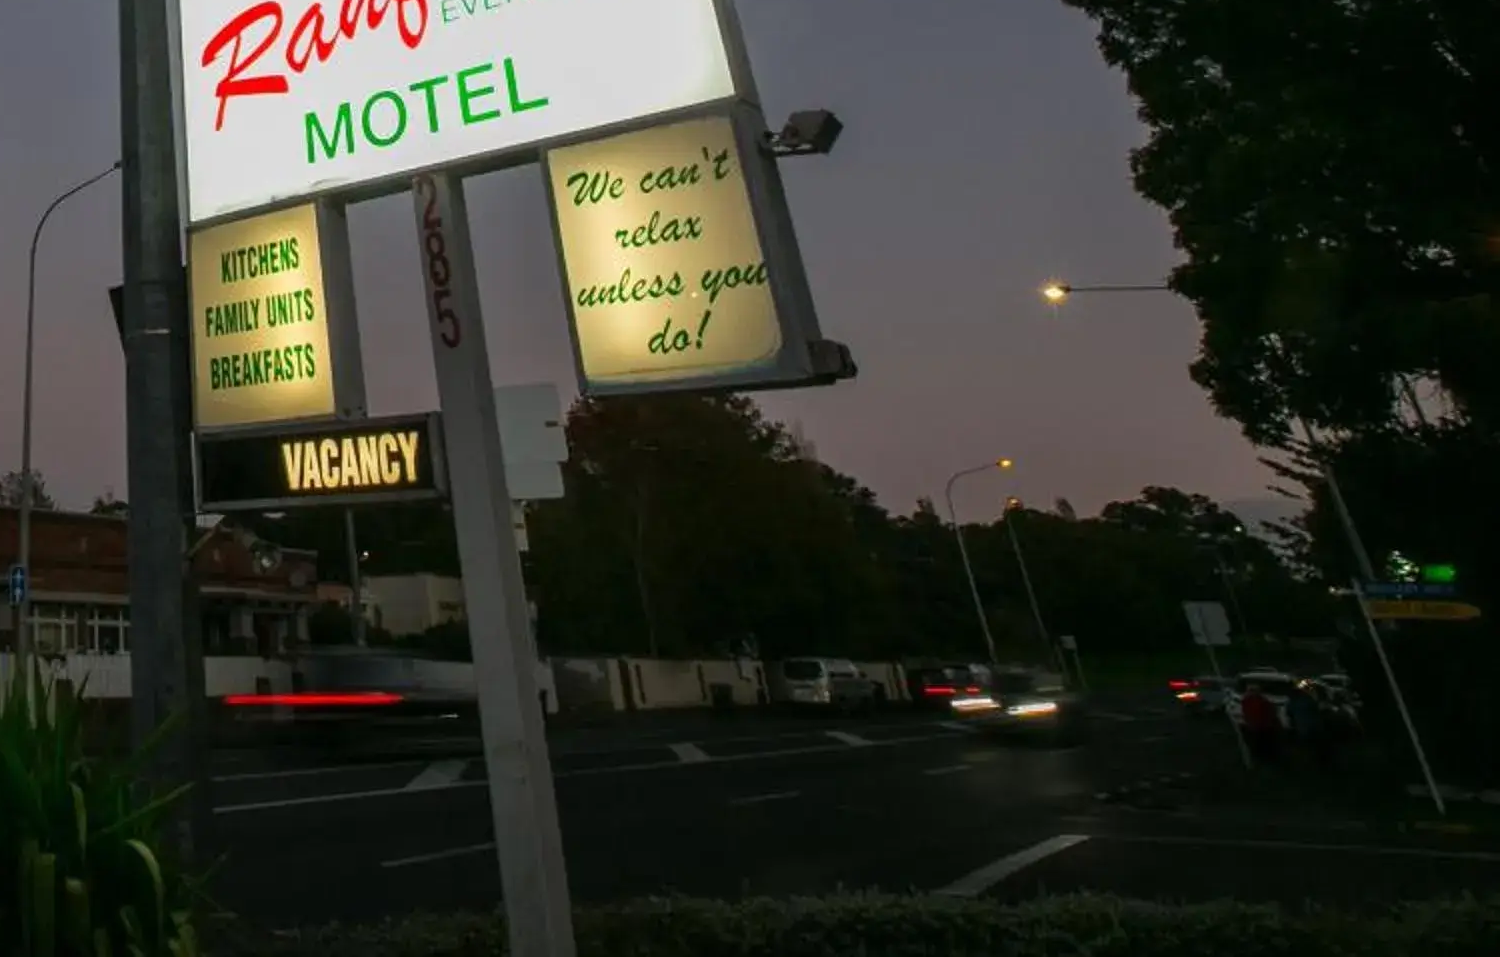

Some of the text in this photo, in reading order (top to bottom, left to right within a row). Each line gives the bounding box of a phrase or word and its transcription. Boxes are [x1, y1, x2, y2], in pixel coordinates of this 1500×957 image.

[303, 57, 550, 165] MOTEL
[566, 146, 731, 206] We can't
[614, 210, 703, 248] relax
[220, 237, 299, 284] KITCHENS
[414, 172, 462, 349] 285
[576, 261, 768, 308] unless you
[205, 288, 315, 338] FAMILY UNITS
[647, 310, 712, 355] do!
[210, 343, 315, 390] BREAKFASTS
[281, 431, 419, 491] VACANCY
